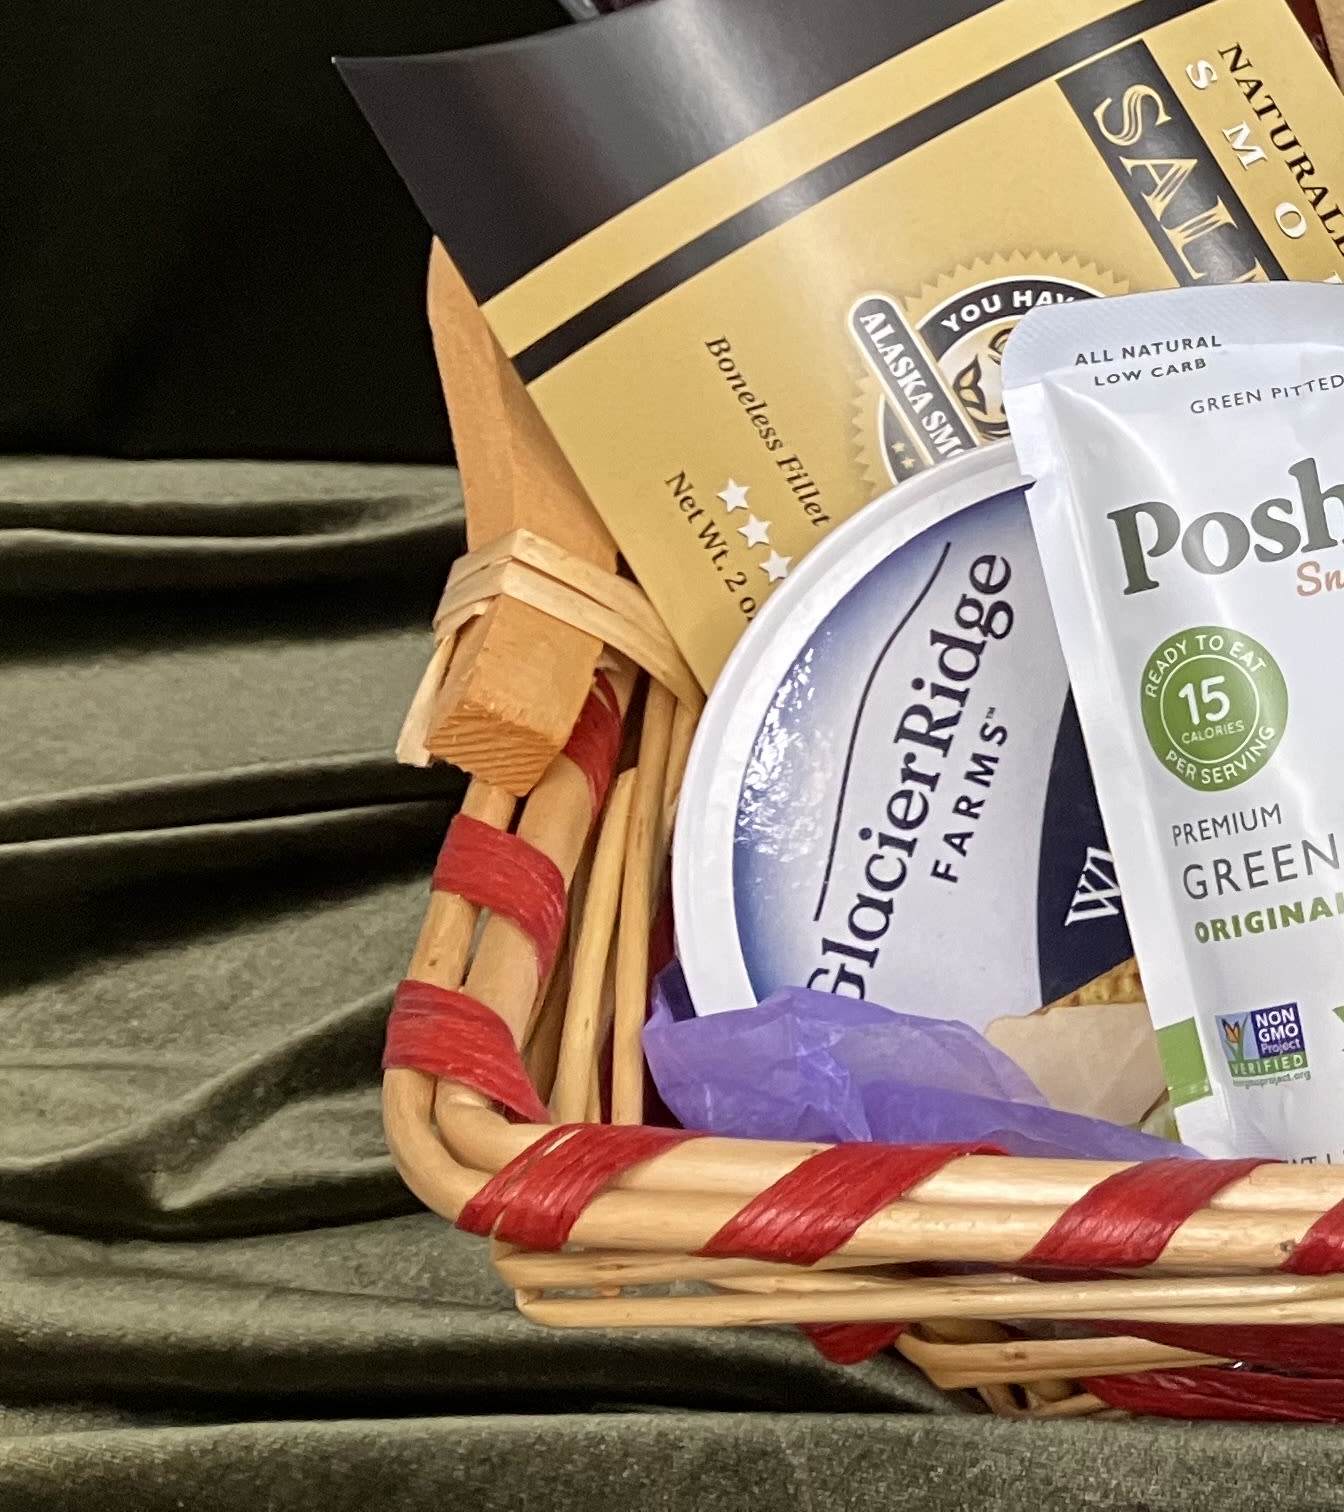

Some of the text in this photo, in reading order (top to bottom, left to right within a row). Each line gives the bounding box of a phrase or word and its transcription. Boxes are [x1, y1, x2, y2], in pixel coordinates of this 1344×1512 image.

[1092, 83, 1266, 281] SAL
[941, 294, 1002, 333] YOU
[859, 311, 935, 414] ALASKA
[1074, 335, 1222, 367] ALL NATURAL
[1094, 357, 1207, 387] LOW CARB
[1190, 389, 1262, 415] GREEN
[1271, 374, 1344, 400] PITTED
[704, 335, 833, 528] Boneless Fillet
[664, 469, 705, 525] Net
[697, 520, 730, 573] Wt.
[724, 571, 748, 593] 2
[1145, 634, 1267, 698] READY TO EAT
[1178, 675, 1231, 726] 15
[1181, 719, 1245, 744] CALORIES
[1165, 725, 1276, 785] PER SERVING
[1171, 802, 1283, 847] PREMIUM
[1182, 832, 1341, 901] GREEN
[1254, 1006, 1296, 1029] NON
[1258, 1022, 1299, 1044] GMO
[1230, 1053, 1304, 1076] VERIFIED
[1260, 1039, 1302, 1055] Project
